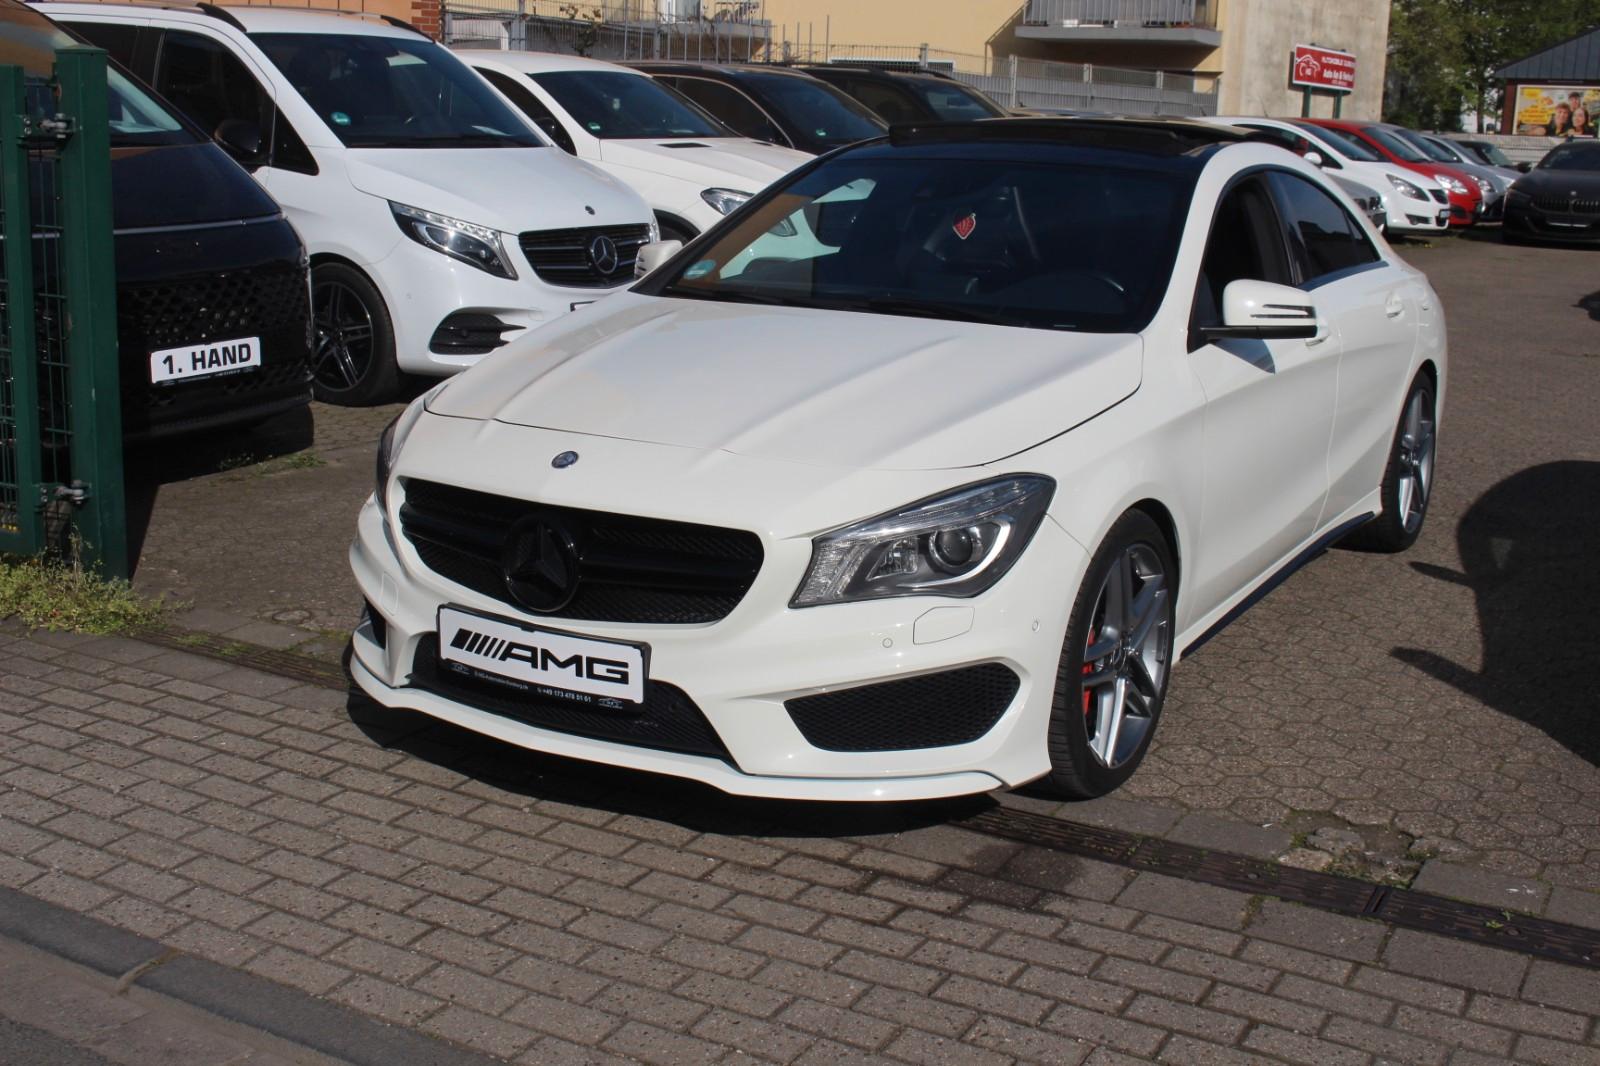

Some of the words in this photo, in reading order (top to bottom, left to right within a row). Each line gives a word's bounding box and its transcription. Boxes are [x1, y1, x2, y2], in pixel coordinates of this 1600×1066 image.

[162, 355, 182, 374] 1.
[191, 343, 251, 371] HAND
[498, 641, 630, 685] AMG
